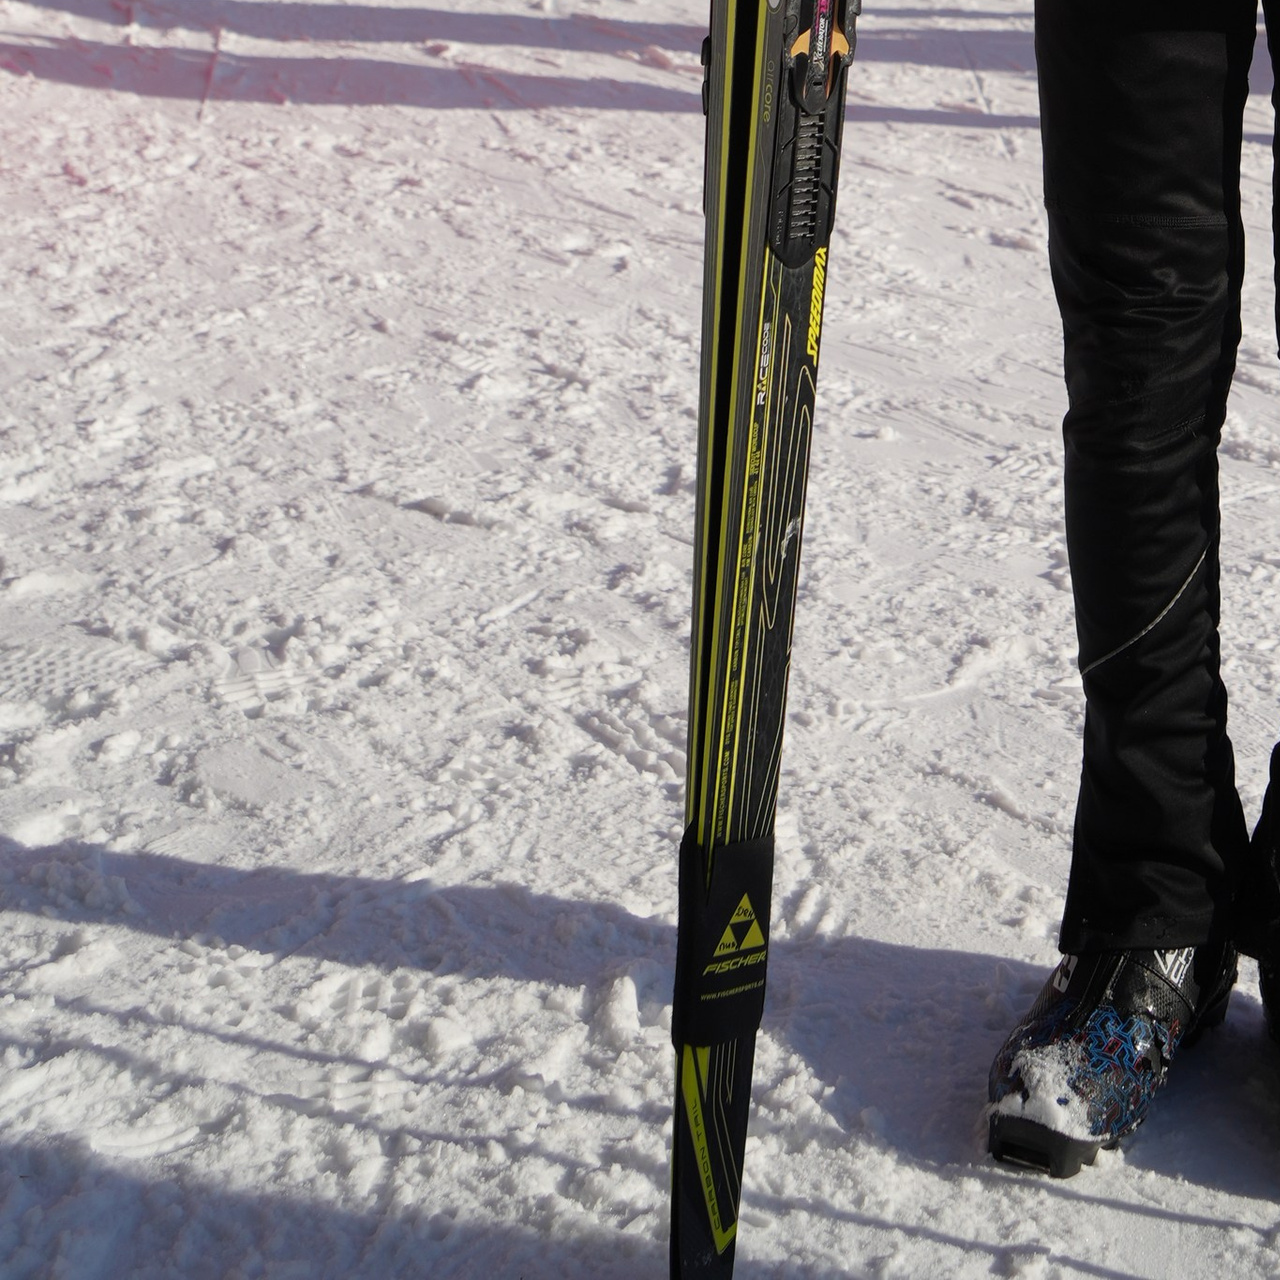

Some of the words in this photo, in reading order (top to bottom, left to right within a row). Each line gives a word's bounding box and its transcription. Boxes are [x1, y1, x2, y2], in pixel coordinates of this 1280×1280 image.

[763, 59, 775, 123] aircore
[702, 950, 766, 976] FISCHER
[692, 1097, 702, 1141] TAIL
[699, 1145, 721, 1231] CARBON
